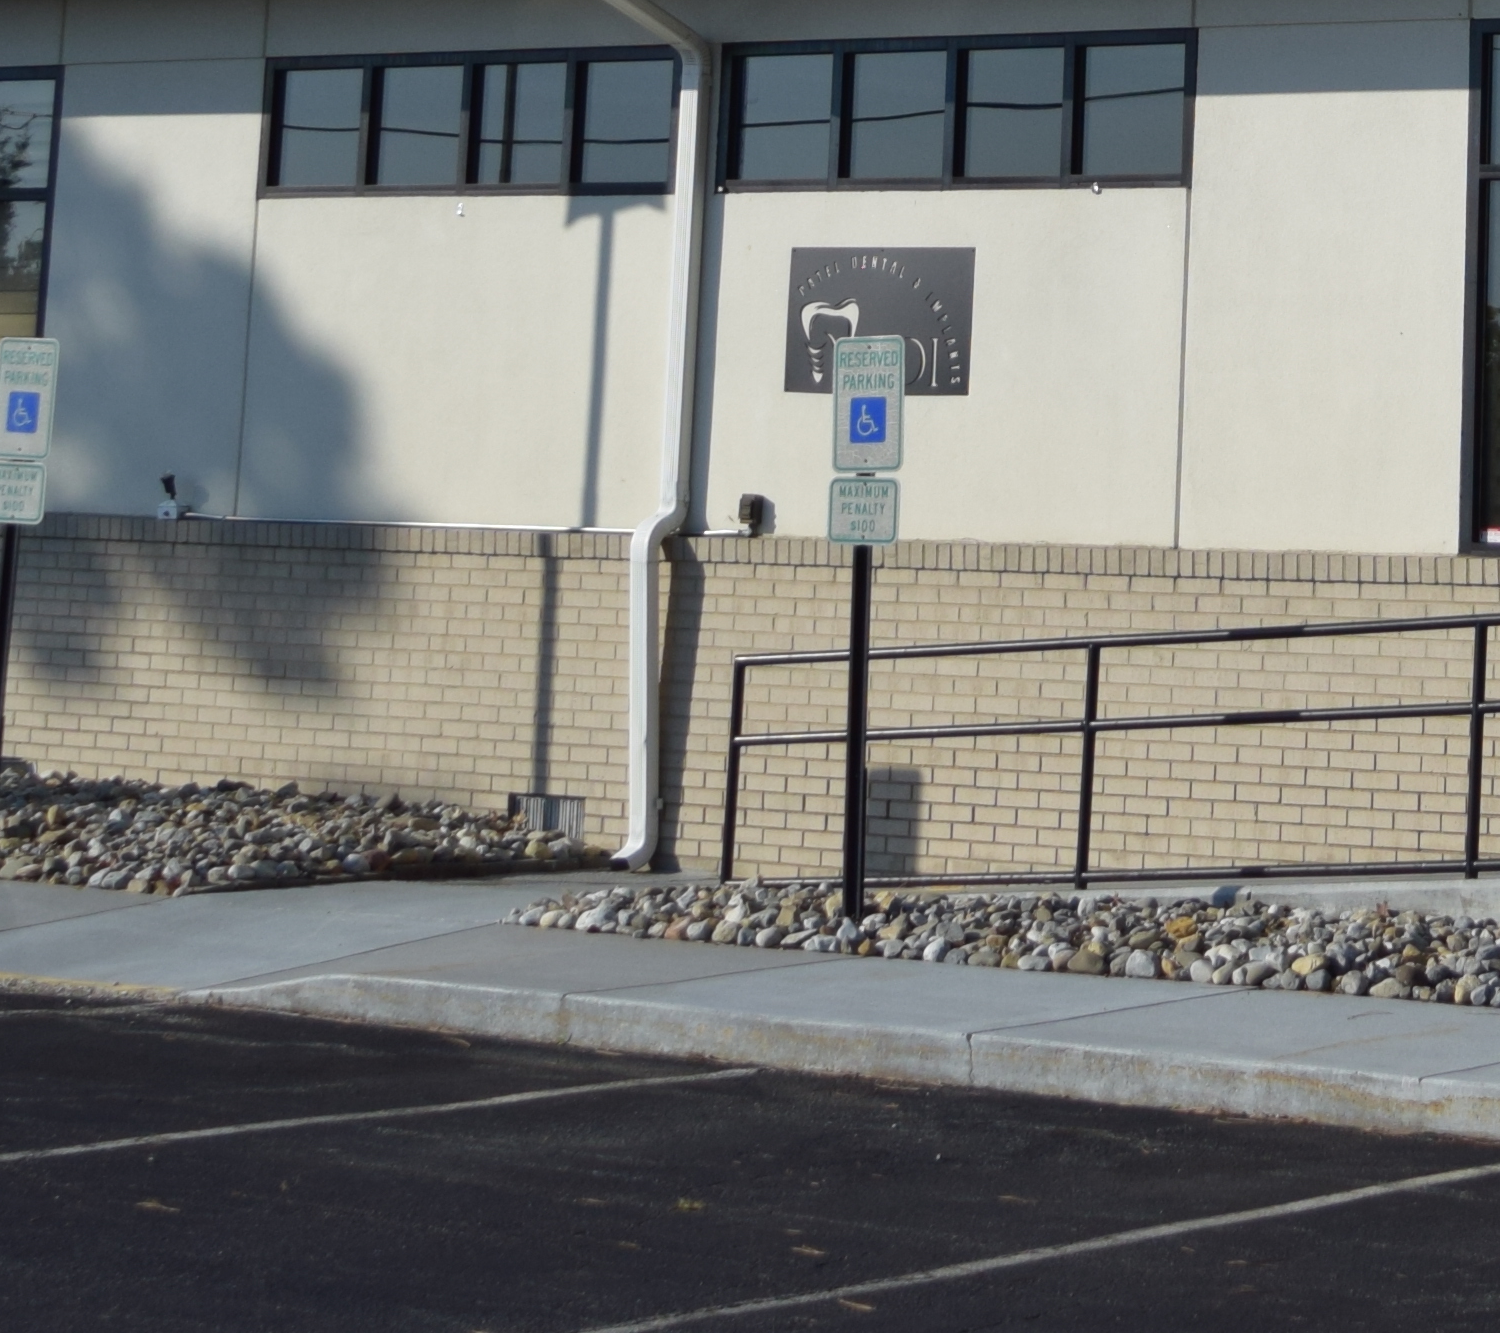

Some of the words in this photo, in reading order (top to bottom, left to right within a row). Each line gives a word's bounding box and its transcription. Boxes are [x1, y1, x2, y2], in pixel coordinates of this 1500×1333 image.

[797, 261, 840, 296] PATEL
[851, 255, 905, 278] DENTAL
[912, 278, 921, 289] &
[925, 291, 961, 384] IMPLANTS
[2, 349, 53, 367] RESERVED
[839, 350, 898, 367] RESERVED
[4, 370, 48, 387] PARKING
[842, 373, 895, 390] PARKING
[839, 485, 888, 498] MAXIMUM
[841, 502, 885, 515] PENALTY
[850, 520, 875, 533] $100
